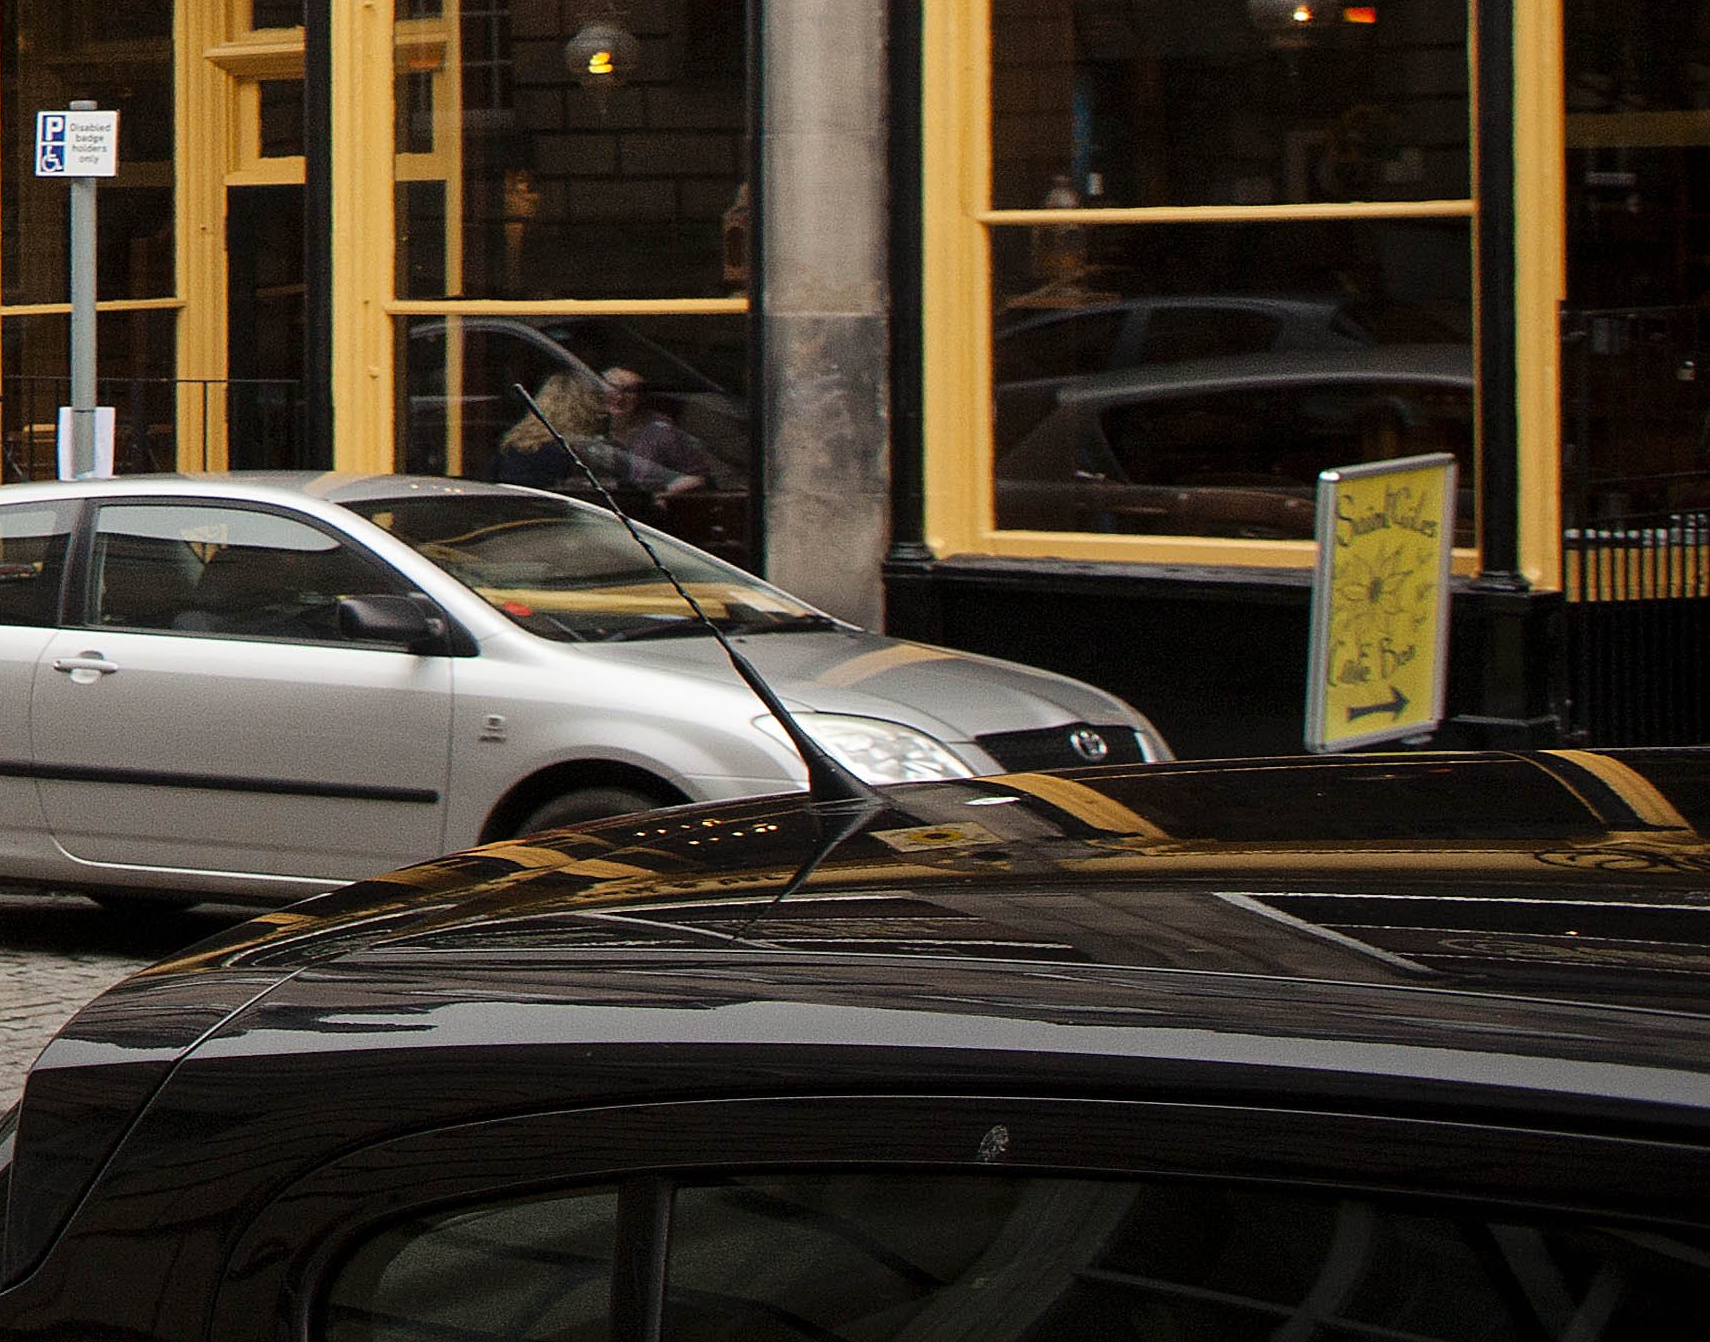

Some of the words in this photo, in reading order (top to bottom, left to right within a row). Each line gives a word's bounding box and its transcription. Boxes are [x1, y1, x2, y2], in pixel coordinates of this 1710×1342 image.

[69, 122, 112, 132] Disabled
[75, 134, 104, 144] badge
[72, 144, 108, 153] holders
[78, 155, 100, 165] only
